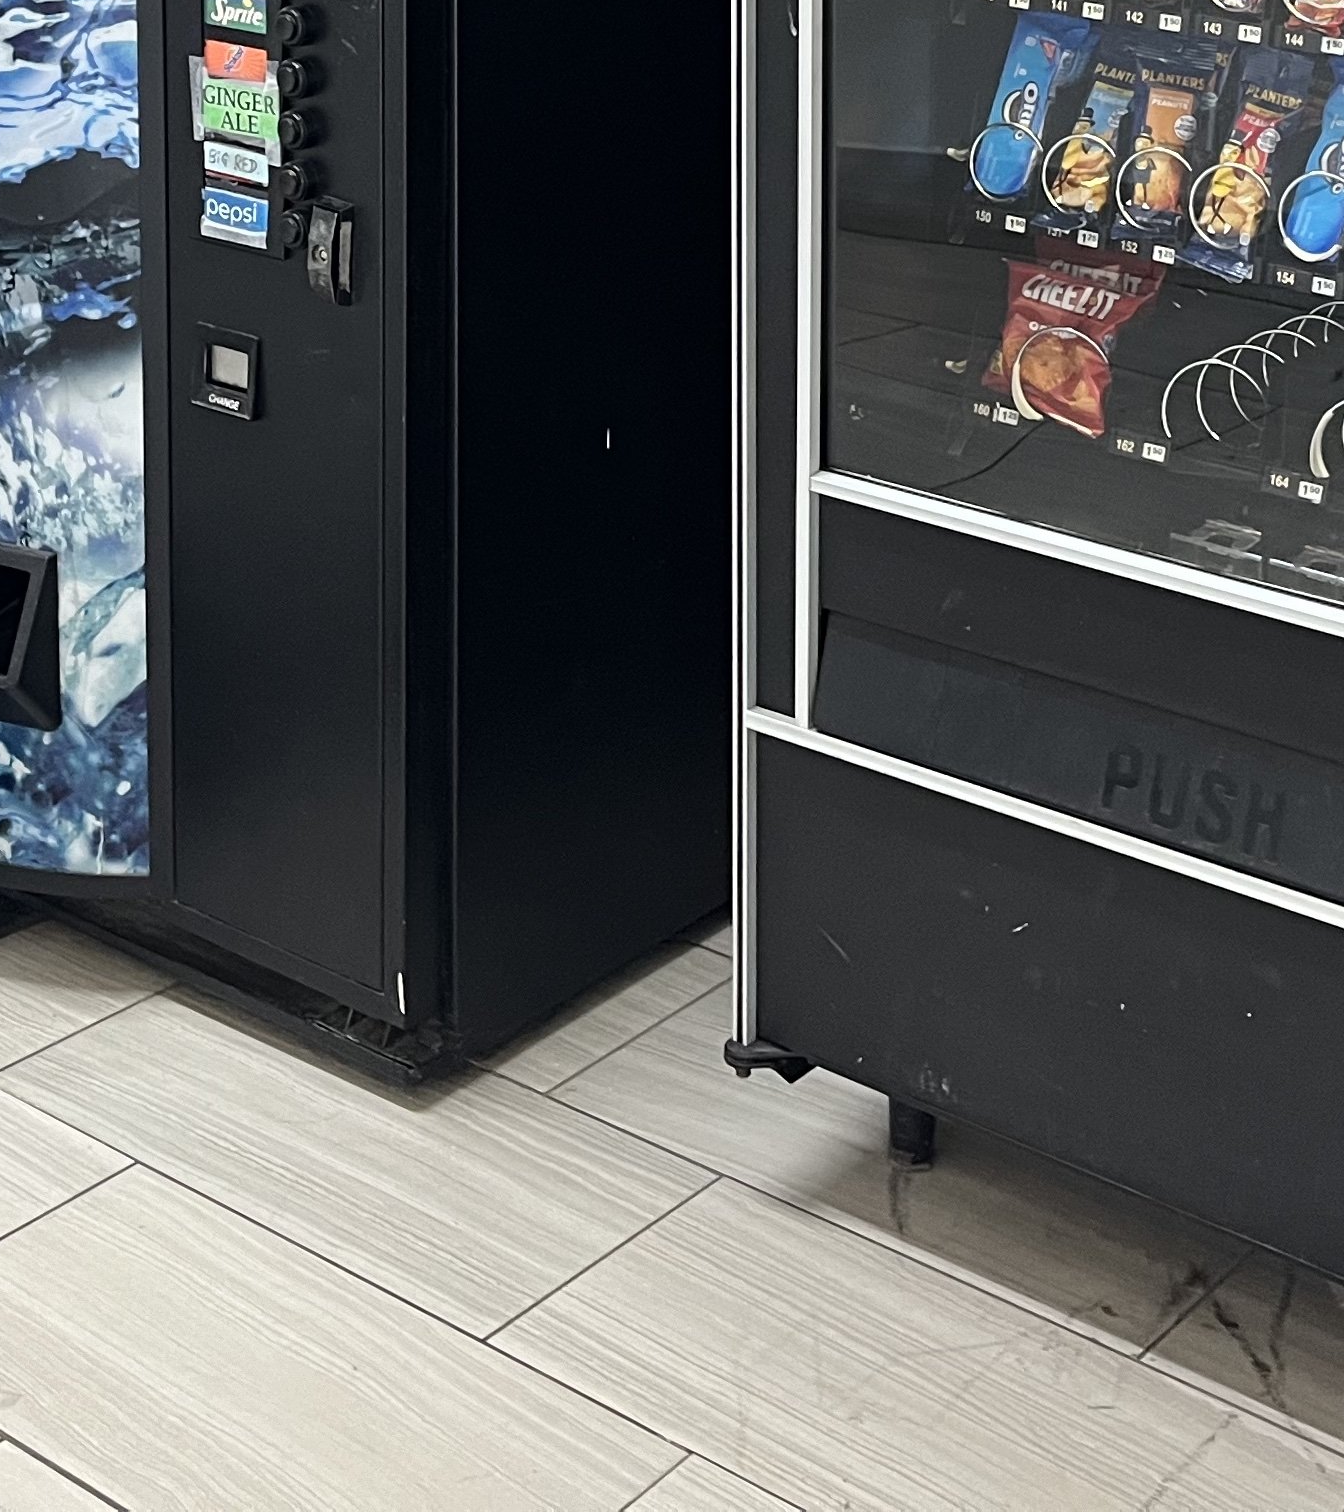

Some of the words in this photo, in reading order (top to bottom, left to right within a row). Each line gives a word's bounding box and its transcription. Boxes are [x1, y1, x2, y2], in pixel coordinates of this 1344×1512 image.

[1050, 0, 1068, 12] 141
[1125, 10, 1144, 24] 142
[1203, 21, 1222, 36] 143
[1284, 32, 1304, 46] 144
[1093, 62, 1136, 85] PLANTE
[1141, 68, 1205, 92] PLANTERS
[204, 84, 276, 115] GINGER
[1245, 84, 1303, 111] PLANTERS
[221, 111, 260, 134] ALE
[233, 153, 258, 174] RED
[206, 197, 258, 225] pepsi
[975, 209, 993, 224] 150
[1119, 240, 1139, 255] 152
[1275, 270, 1296, 285] 154
[208, 393, 240, 411] CHANGE
[973, 402, 991, 417] 160
[1115, 438, 1135, 453] 162
[1269, 474, 1290, 489] 164
[1101, 744, 1286, 862] PUSH
